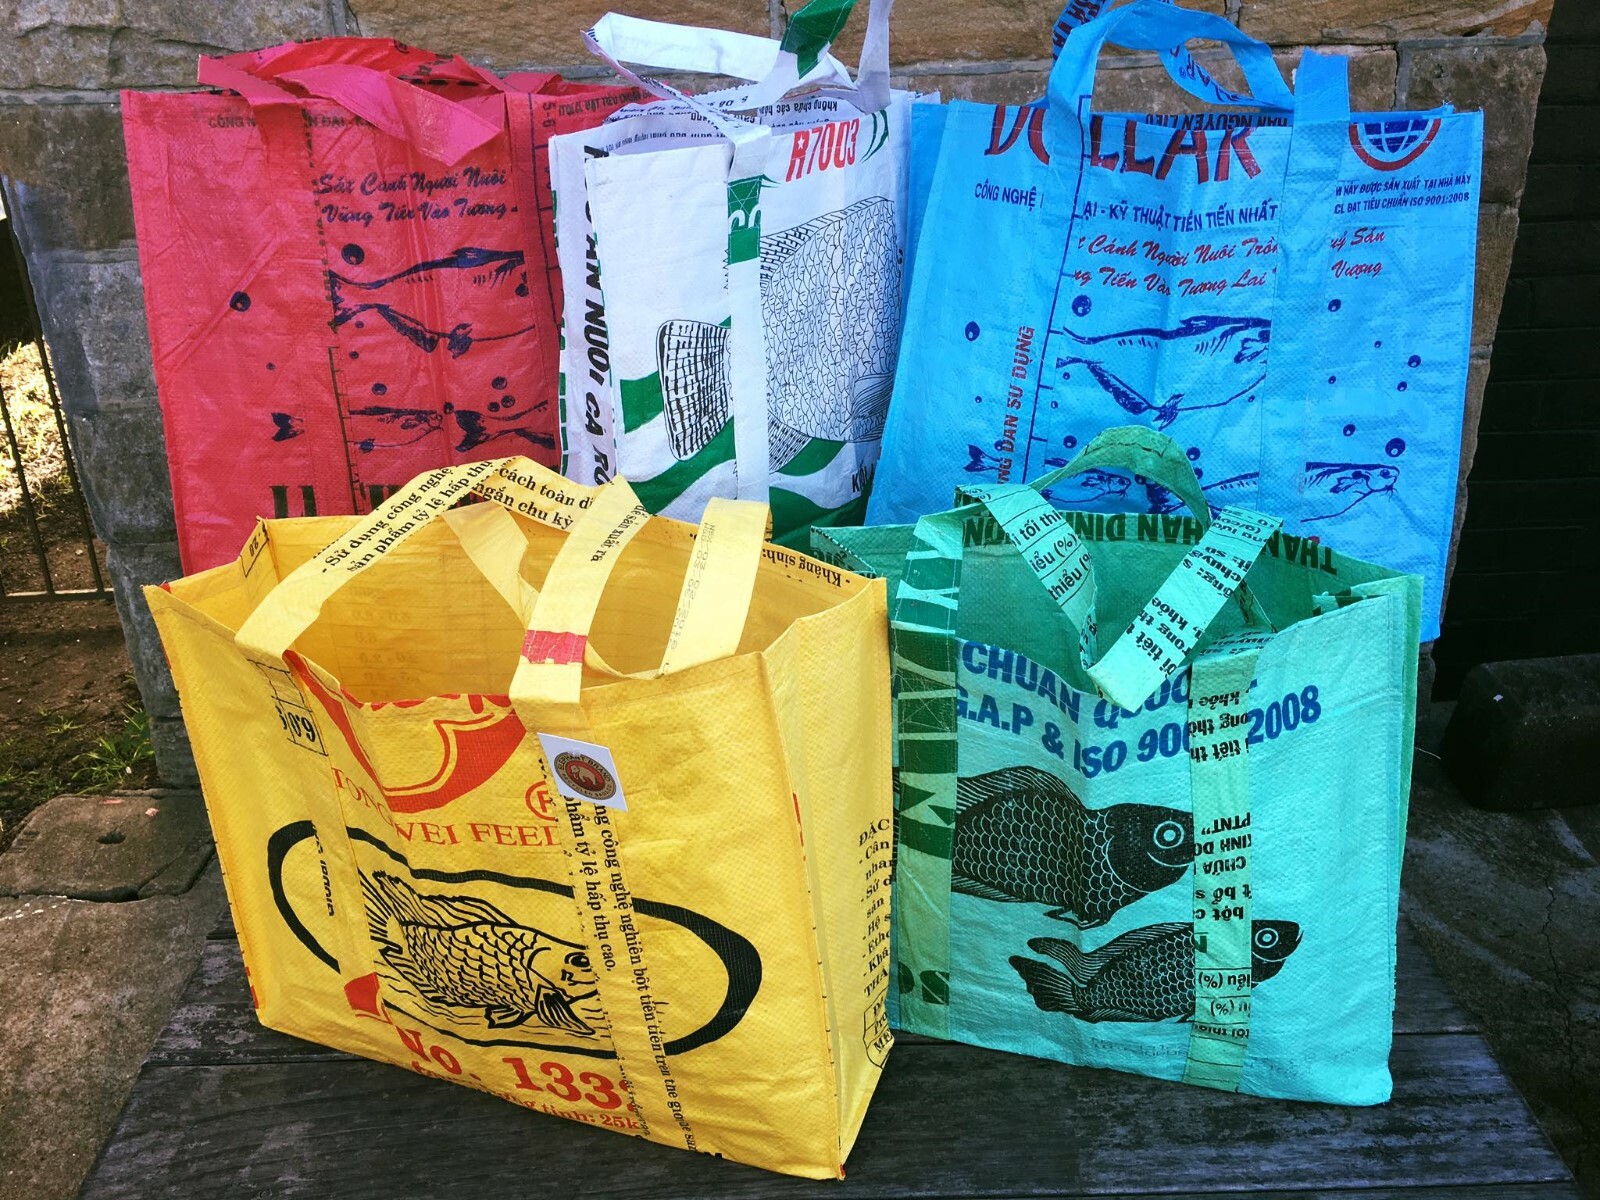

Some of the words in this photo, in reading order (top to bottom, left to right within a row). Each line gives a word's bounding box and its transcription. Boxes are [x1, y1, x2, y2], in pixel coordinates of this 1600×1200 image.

[776, 104, 791, 116] các
[785, 118, 861, 183] R7003
[975, 178, 999, 199] CÔNG
[1002, 185, 1037, 210] NGHỆ
[1359, 180, 1382, 196] ĐƯỢC
[1401, 175, 1421, 191] XUẤT
[1424, 178, 1437, 192] TẠI
[1108, 200, 1128, 221] KỸ
[1133, 205, 1171, 231] THUẬT
[1205, 202, 1234, 229] TIẾN
[1238, 197, 1278, 228] NHẤT
[1347, 201, 1361, 216] ĐẠT
[1363, 197, 1380, 211] TIÊU
[1381, 191, 1409, 209] CHUẨN
[1410, 196, 1424, 207] ISO
[1425, 191, 1470, 206] 9001:2008
[1088, 234, 1138, 257] Cánh
[1142, 241, 1189, 267] Người
[1194, 243, 1236, 266] Nuôi
[1099, 266, 1138, 289] Tiến
[1331, 260, 1383, 281] Vượng
[498, 465, 537, 491] cách
[540, 484, 575, 508] toàn
[349, 517, 392, 553] dụng
[386, 490, 422, 522] công
[418, 466, 454, 494] nghệ
[375, 520, 414, 559] phẩm
[426, 496, 447, 513] lệ
[440, 478, 470, 502] hấp
[467, 459, 494, 478] thụ
[472, 479, 515, 509] ngắn
[517, 500, 549, 522] chu
[553, 511, 575, 531] kỳ
[1019, 518, 1041, 541] tối
[590, 549, 607, 563] ra
[762, 548, 796, 569] sinh:
[1054, 532, 1078, 558] (%)
[799, 555, 843, 588] Kháng
[1047, 569, 1083, 601] thiểu
[1152, 597, 1188, 631] khỏe
[1135, 631, 1164, 662] tiết
[1041, 721, 1065, 760] &
[1073, 738, 1128, 780] ISO
[1211, 738, 1242, 763] tiết
[859, 818, 890, 847] ĐẶC
[600, 830, 621, 870] công
[865, 841, 890, 860] Cân
[579, 861, 599, 876] lệ
[1202, 855, 1247, 876] CHỨA
[585, 880, 607, 911] hấp
[609, 872, 634, 911] nghệ
[593, 913, 609, 941] thụ
[868, 915, 881, 937] Hệ
[1212, 904, 1245, 922] bột
[619, 912, 642, 966] nghiên
[631, 966, 649, 992] bột
[1198, 971, 1224, 990] (%)
[1210, 999, 1236, 1017] (%)
